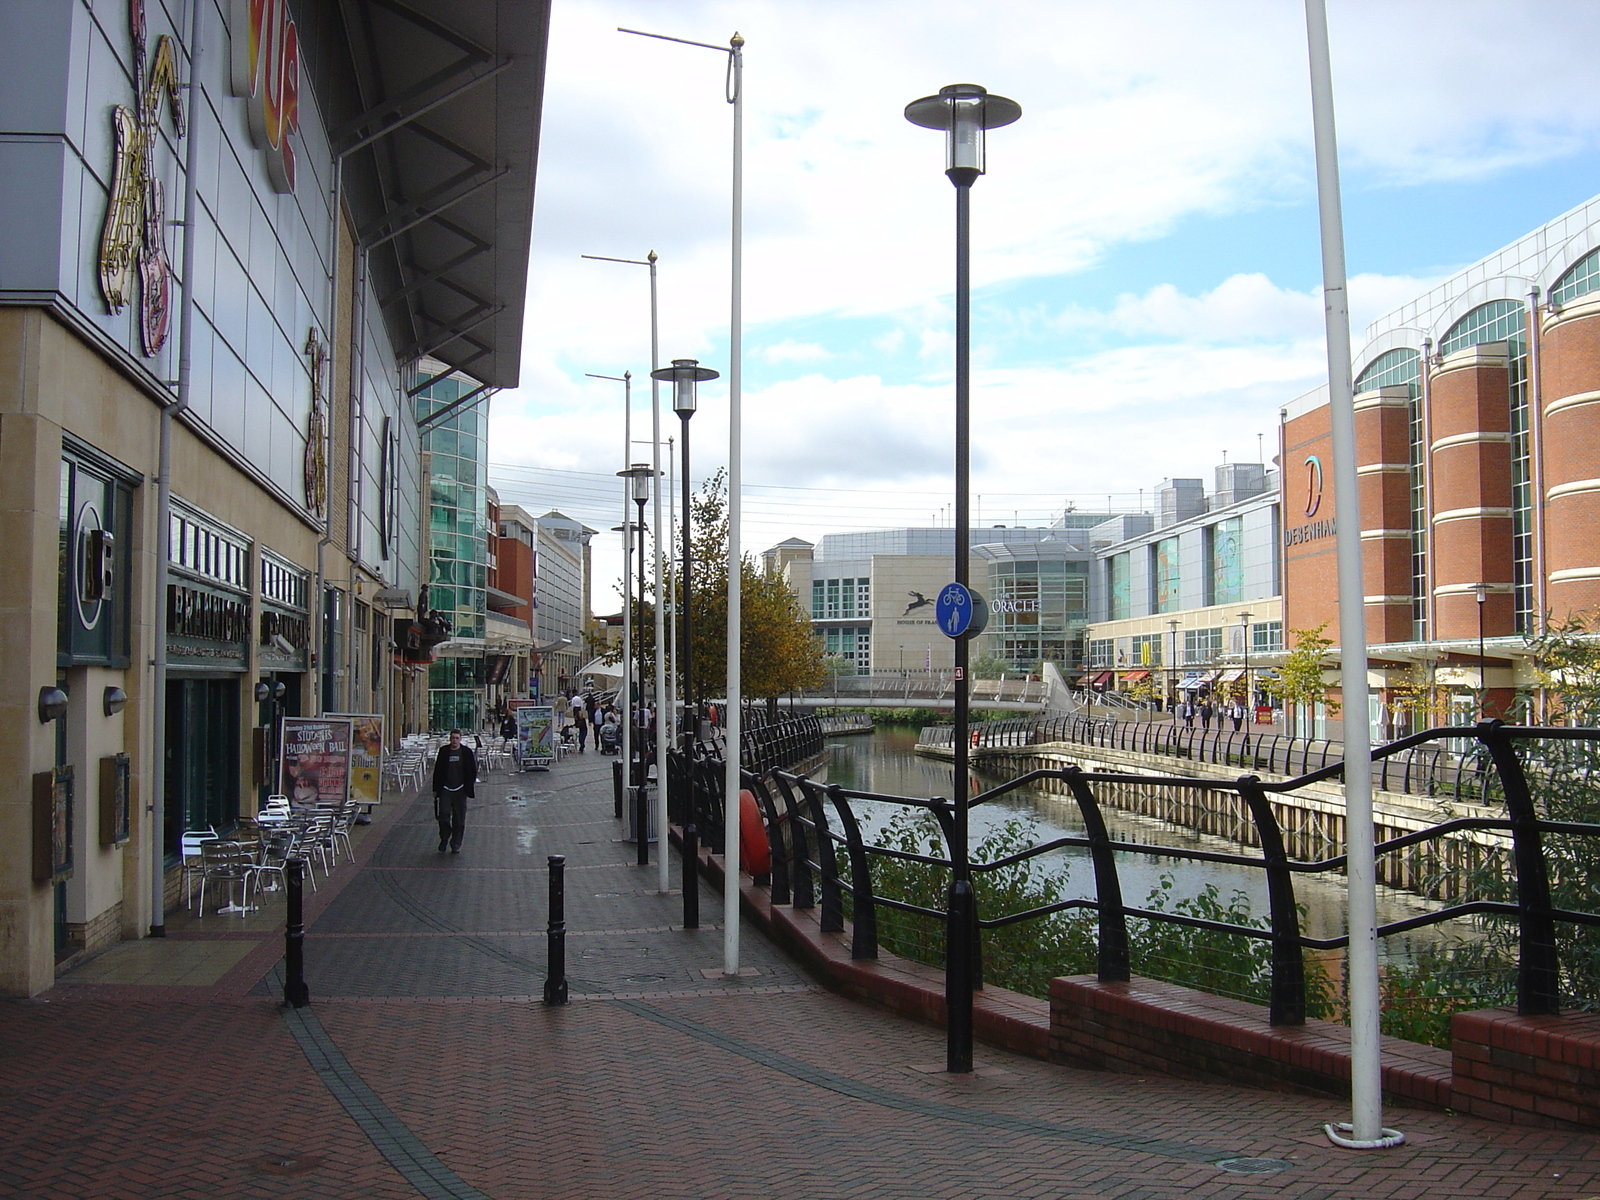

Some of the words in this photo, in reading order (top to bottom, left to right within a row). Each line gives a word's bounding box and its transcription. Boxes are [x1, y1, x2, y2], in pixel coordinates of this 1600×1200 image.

[1285, 517, 1337, 546] DEBENHAM
[992, 599, 1040, 613] ORACLE
[329, 741, 347, 752] BALL
